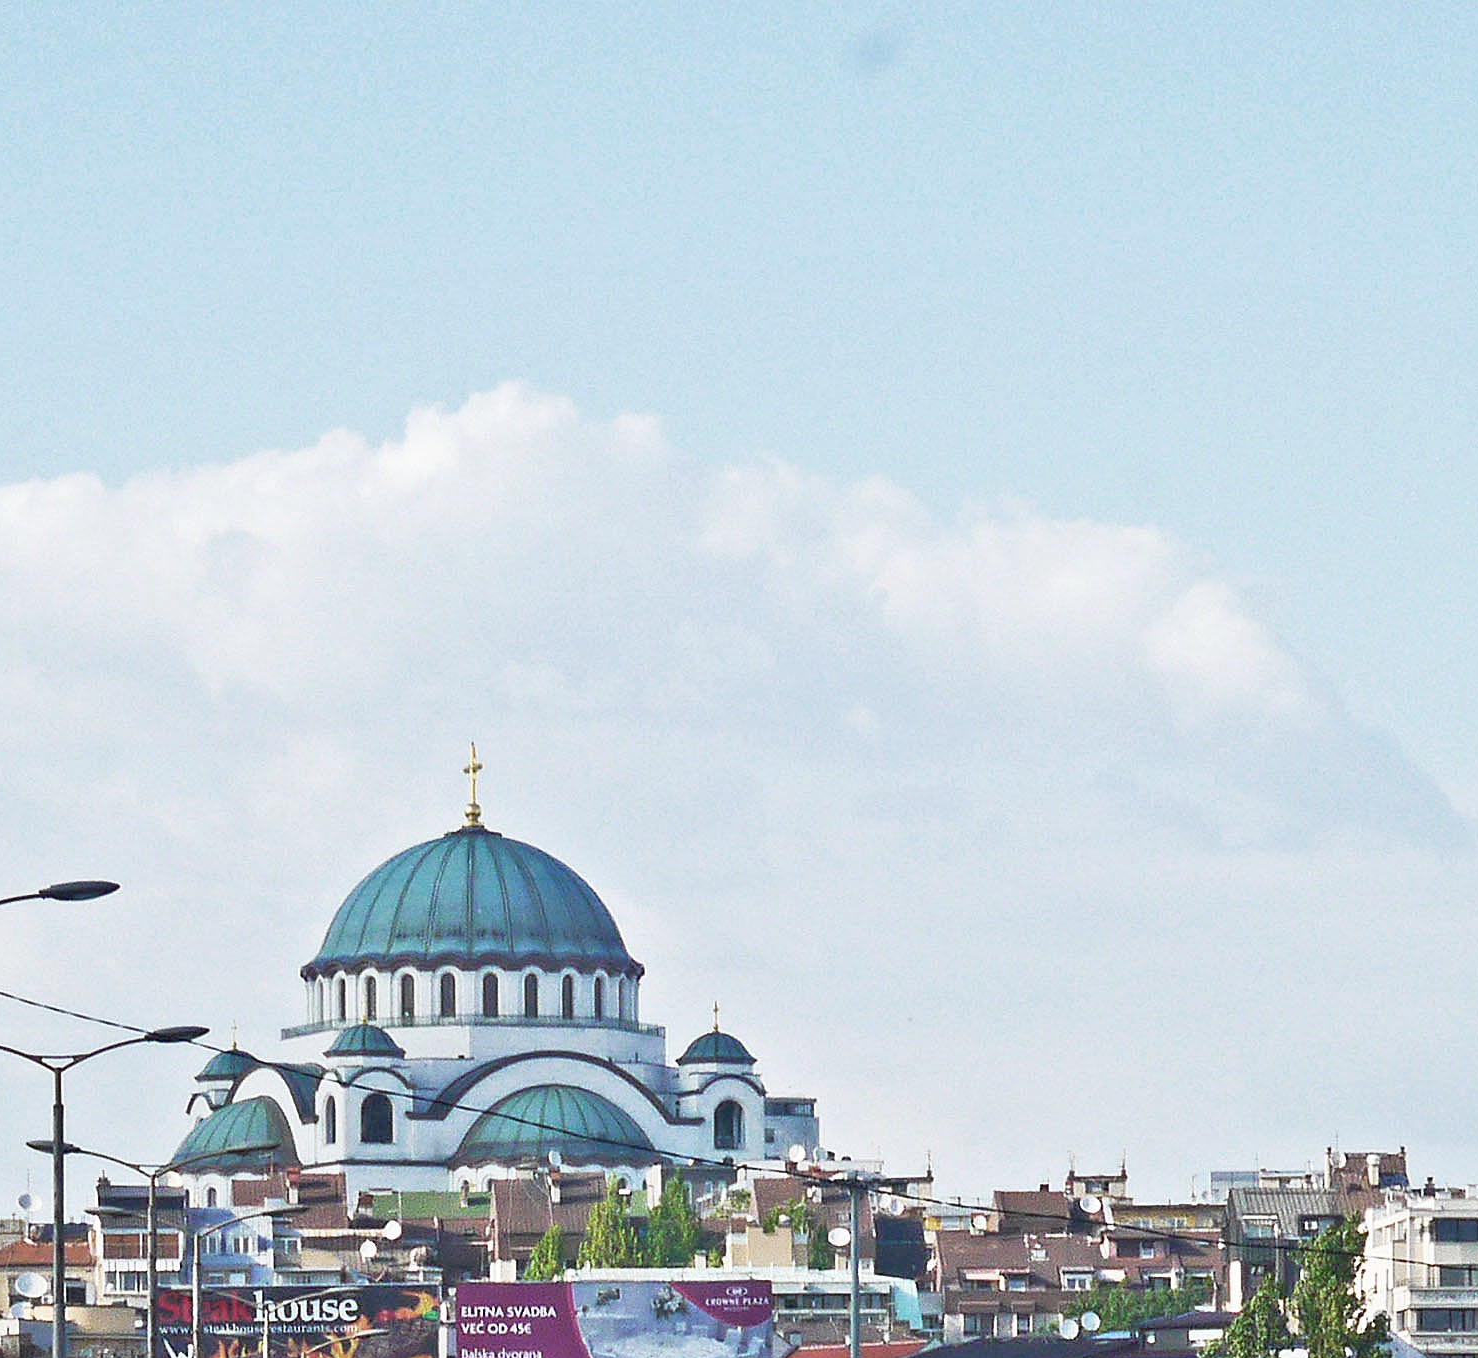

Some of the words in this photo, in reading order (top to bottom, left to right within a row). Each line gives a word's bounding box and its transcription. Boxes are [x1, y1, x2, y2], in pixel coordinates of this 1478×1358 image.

[705, 1298, 740, 1307] CROWNE
[743, 1297, 769, 1305] PLAZA
[461, 1306, 504, 1318] ELITNA
[507, 1306, 557, 1318] SVADBA
[487, 1323, 508, 1335] OD
[510, 1323, 532, 1334] 45€
